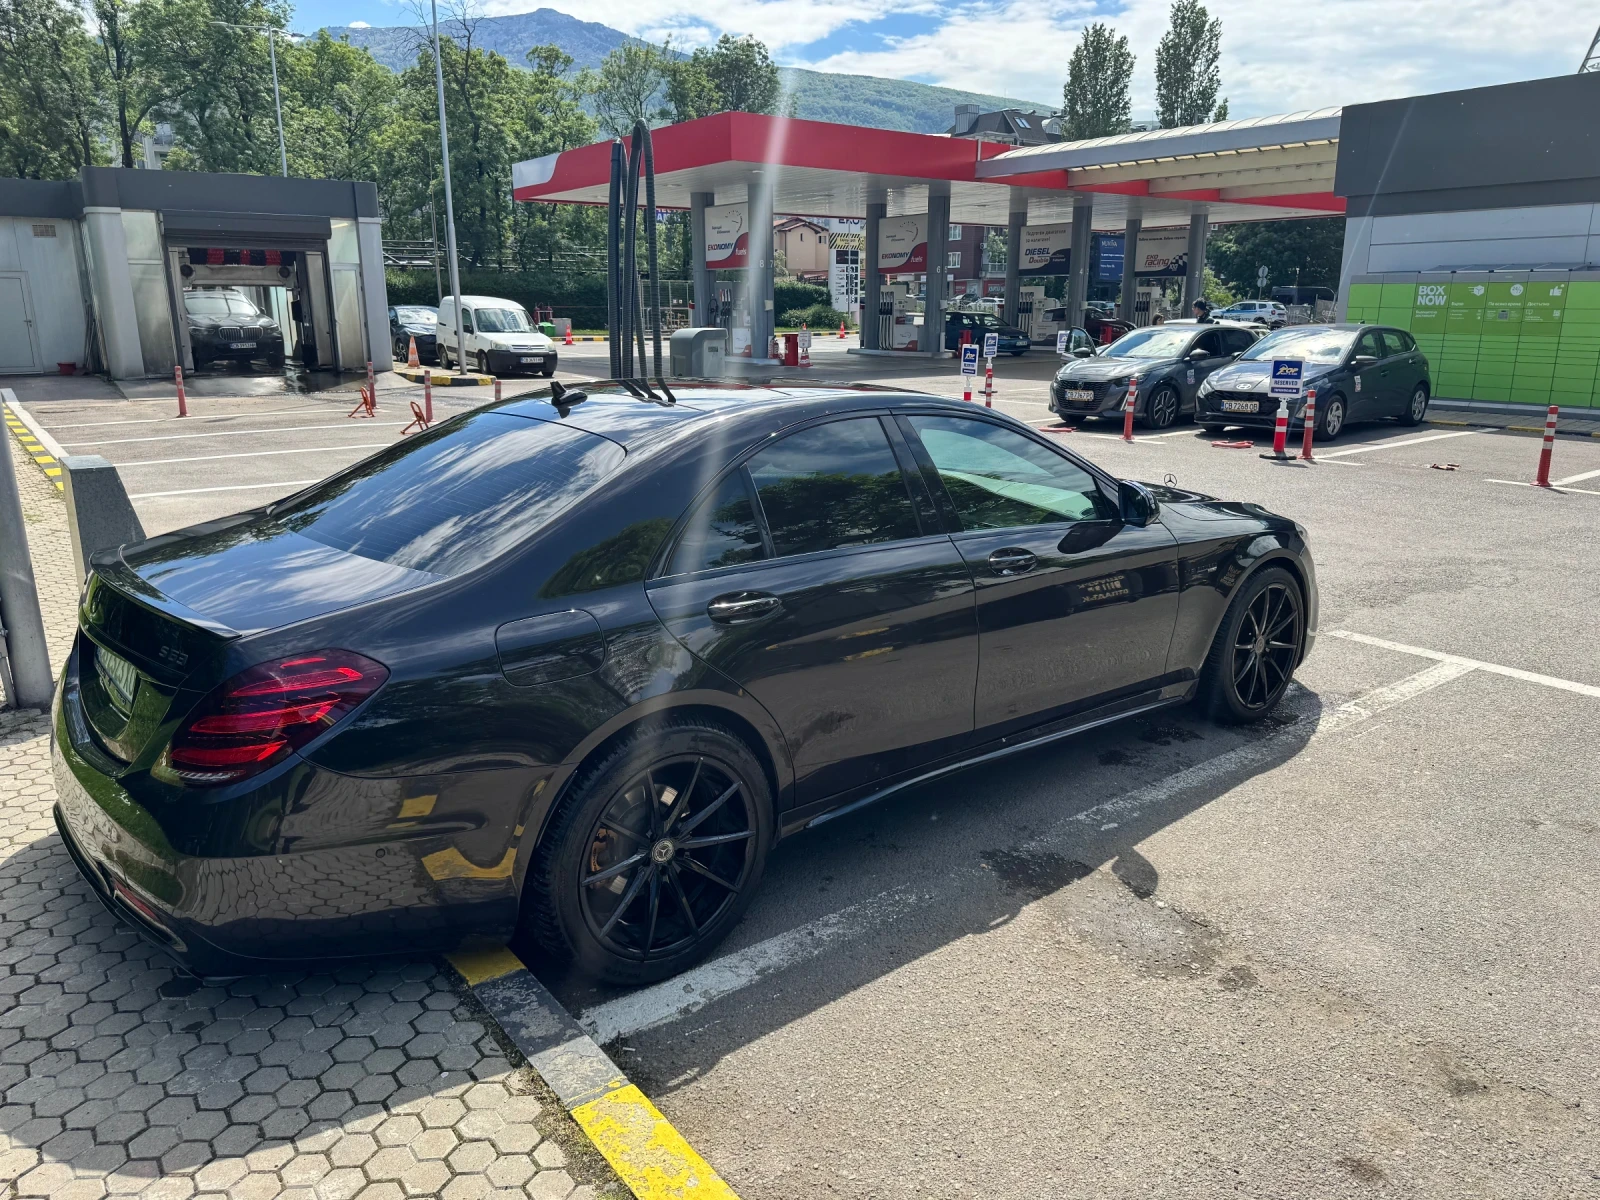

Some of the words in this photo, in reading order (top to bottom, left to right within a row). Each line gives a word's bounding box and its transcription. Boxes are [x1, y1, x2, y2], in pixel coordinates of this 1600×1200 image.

[707, 243, 734, 251] EKONOMY
[735, 248, 747, 256] fuels
[1024, 247, 1051, 256] DIESEL
[881, 252, 910, 260] EKONOMY
[1144, 258, 1170, 266] racing
[1418, 285, 1446, 296] BOX
[1417, 295, 1447, 306] NOW
